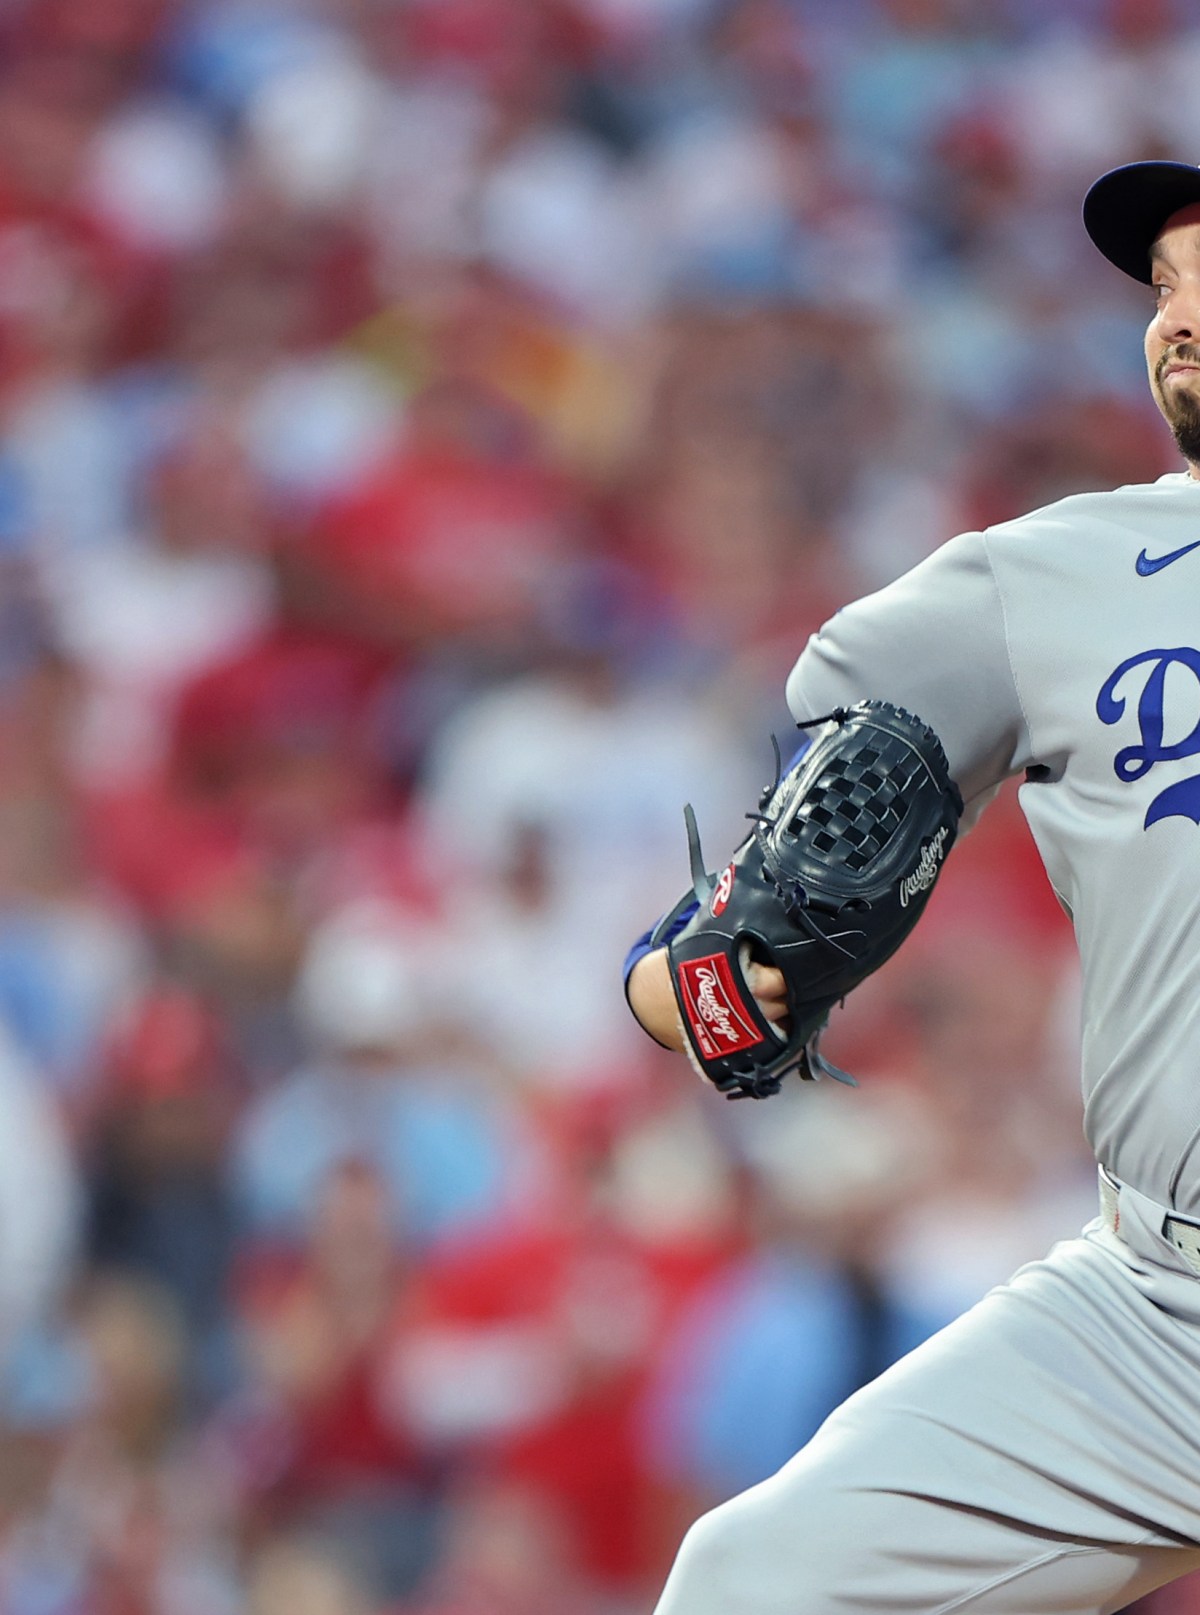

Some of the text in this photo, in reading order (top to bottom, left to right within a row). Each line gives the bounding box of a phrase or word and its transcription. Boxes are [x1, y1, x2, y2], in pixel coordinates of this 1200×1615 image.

[712, 867, 732, 911] R
[900, 826, 949, 908] Rawlings
[695, 967, 740, 1044] Rawlings
